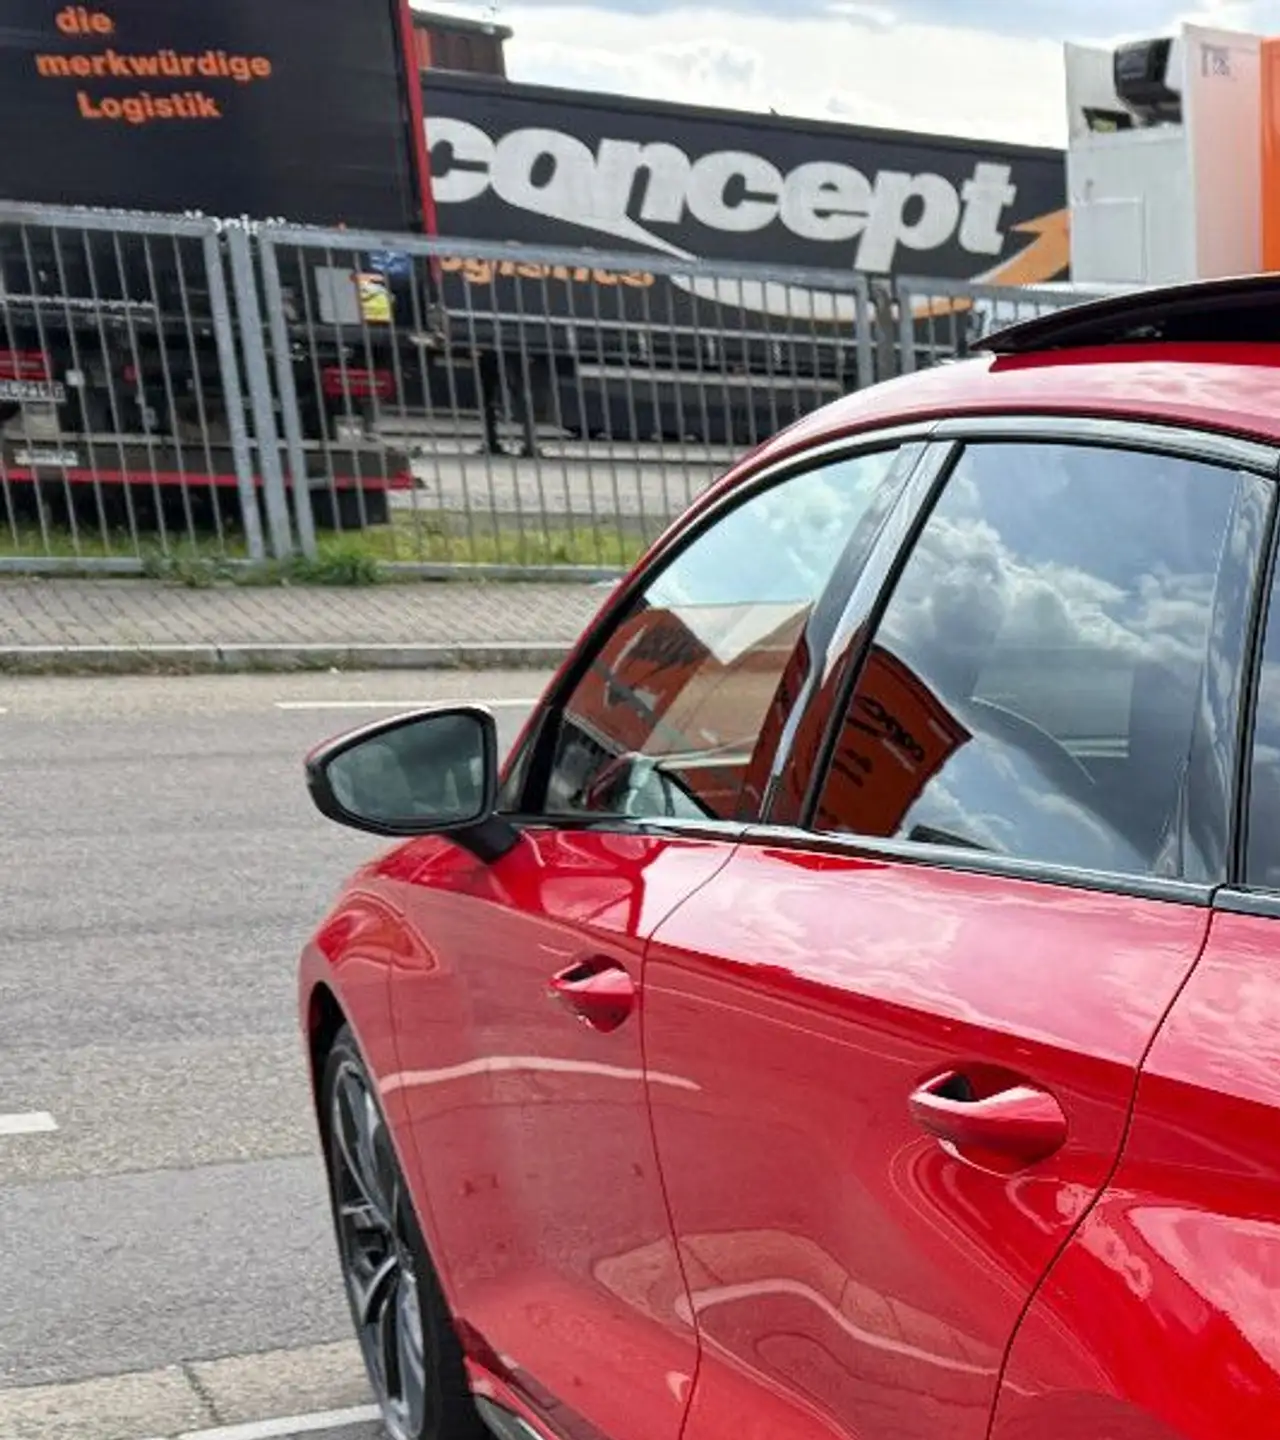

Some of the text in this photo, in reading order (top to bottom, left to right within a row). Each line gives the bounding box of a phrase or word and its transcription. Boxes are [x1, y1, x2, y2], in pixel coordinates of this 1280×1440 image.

[55, 6, 116, 34] die
[36, 49, 272, 81] merkwürdige
[76, 90, 222, 123] Logistik
[423, 116, 1016, 273] concept
